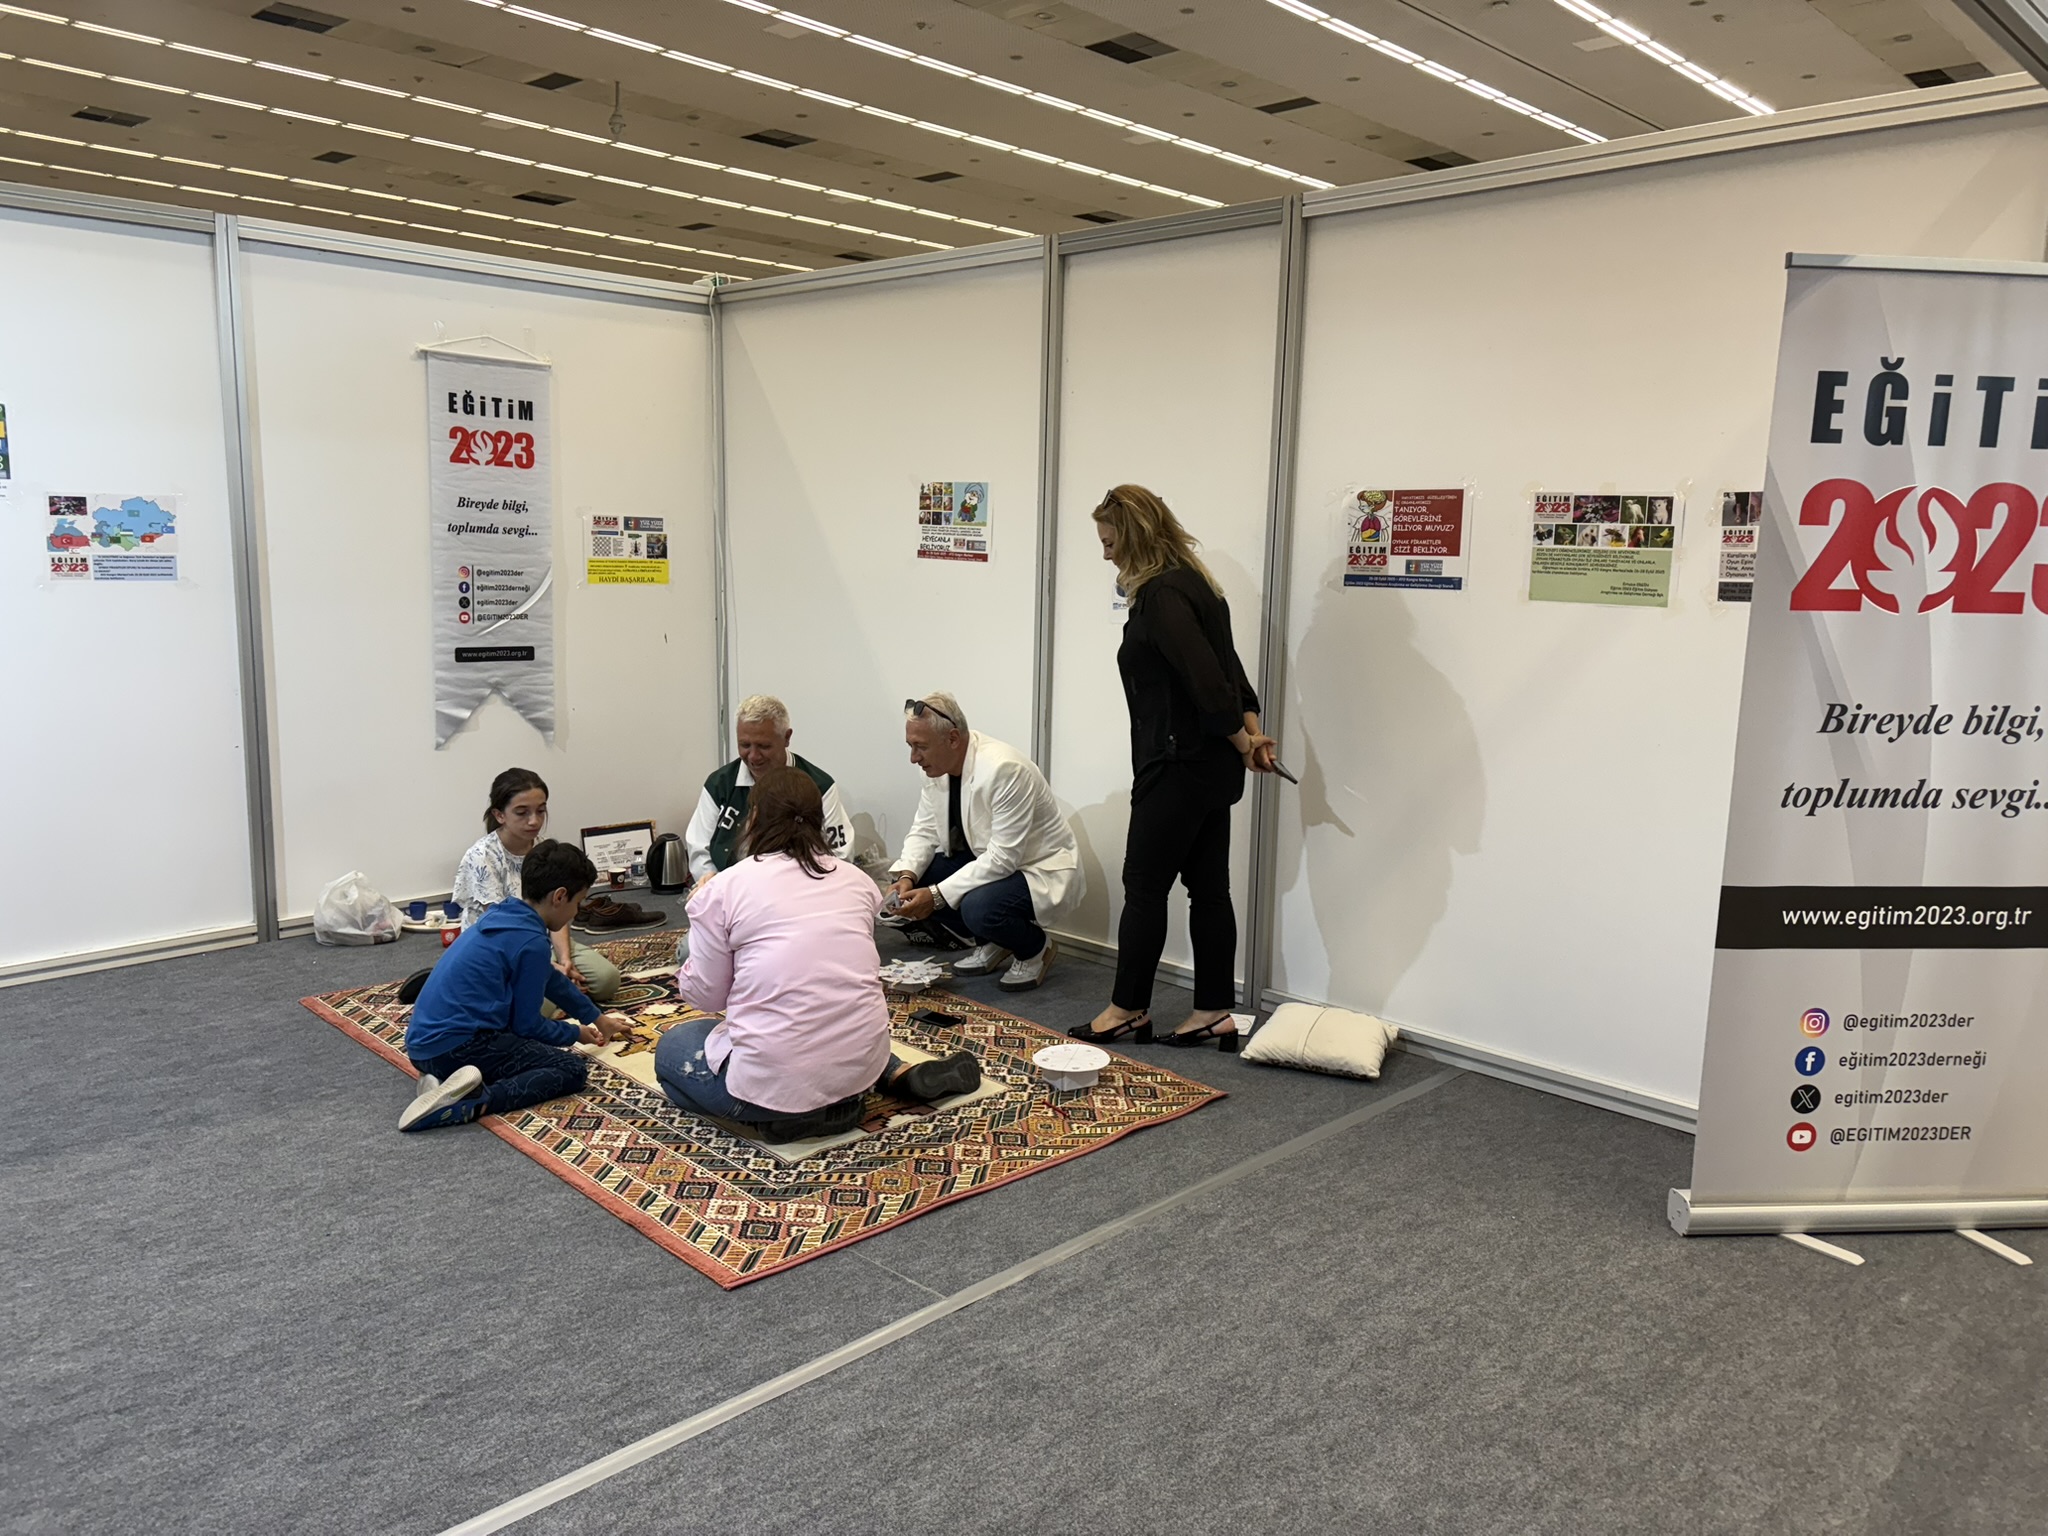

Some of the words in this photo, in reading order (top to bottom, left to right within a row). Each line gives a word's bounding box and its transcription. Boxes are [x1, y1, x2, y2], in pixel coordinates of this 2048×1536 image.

[448, 425, 535, 470] 2023
[456, 496, 499, 512] Bireyde
[502, 499, 529, 514] bilgi,
[1392, 523, 1423, 532] BİLİYOR
[1425, 524, 1455, 532] MUYUZ?
[1393, 514, 1442, 523] GÖREVLERİNİ
[447, 522, 499, 535] toplumda
[501, 525, 538, 538] sevgi...
[1393, 545, 1411, 553] SİZİ
[1789, 478, 2048, 615] 202
[476, 569, 524, 577] @egitim2023der
[476, 584, 531, 593] eğitim2023derneği
[476, 599, 518, 607] egitim2023der
[461, 650, 528, 658] www.egitim2023.org.tr
[1817, 703, 1954, 743] Bireyde
[1961, 704, 2045, 744] bilgi,
[1780, 778, 1943, 817] toplumda
[826, 824, 847, 848] 25
[1781, 905, 2032, 930] www.egitim2023.org.tr
[1843, 1013, 1975, 1031] @egitim2023der
[1838, 1050, 1988, 1069] eğitim2023derneği
[1834, 1089, 1949, 1107] egitim2023der
[1830, 1126, 1972, 1145] @EGITIM2023DER
